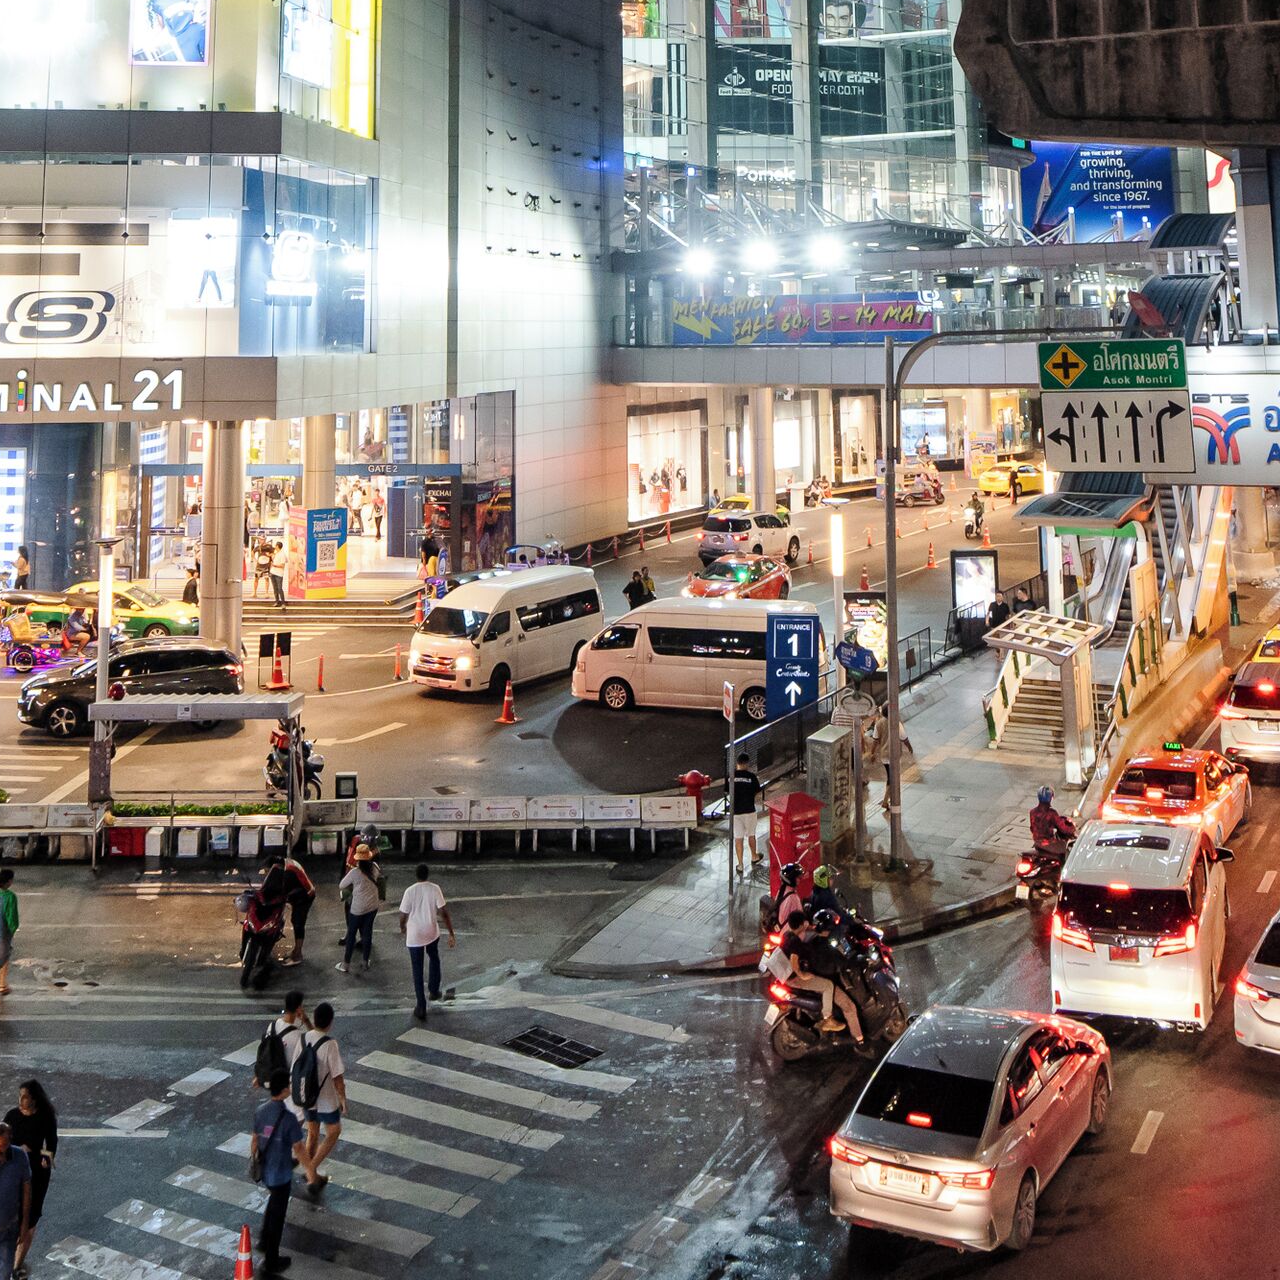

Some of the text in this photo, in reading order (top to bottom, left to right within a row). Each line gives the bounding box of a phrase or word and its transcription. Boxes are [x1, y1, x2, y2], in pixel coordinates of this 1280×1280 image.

[1080, 157, 1126, 169] growing,
[1089, 168, 1134, 179] thriving,
[1070, 179, 1163, 191] and transforming
[1093, 191, 1150, 202] since 1967.
[817, 310, 830, 326] 3
[855, 307, 877, 325] 14
[880, 304, 924, 324] MAY
[733, 311, 775, 337] SALE
[1093, 343, 1180, 372] อโศกมนตรี
[1103, 374, 1173, 385] Asok Montri
[131, 368, 184, 412] 21
[1192, 393, 1250, 404] BTS
[367, 464, 399, 473] GATE 2
[776, 623, 810, 631] ENTRANCE
[787, 633, 798, 657] 1
[1165, 741, 1181, 750] TAXI
